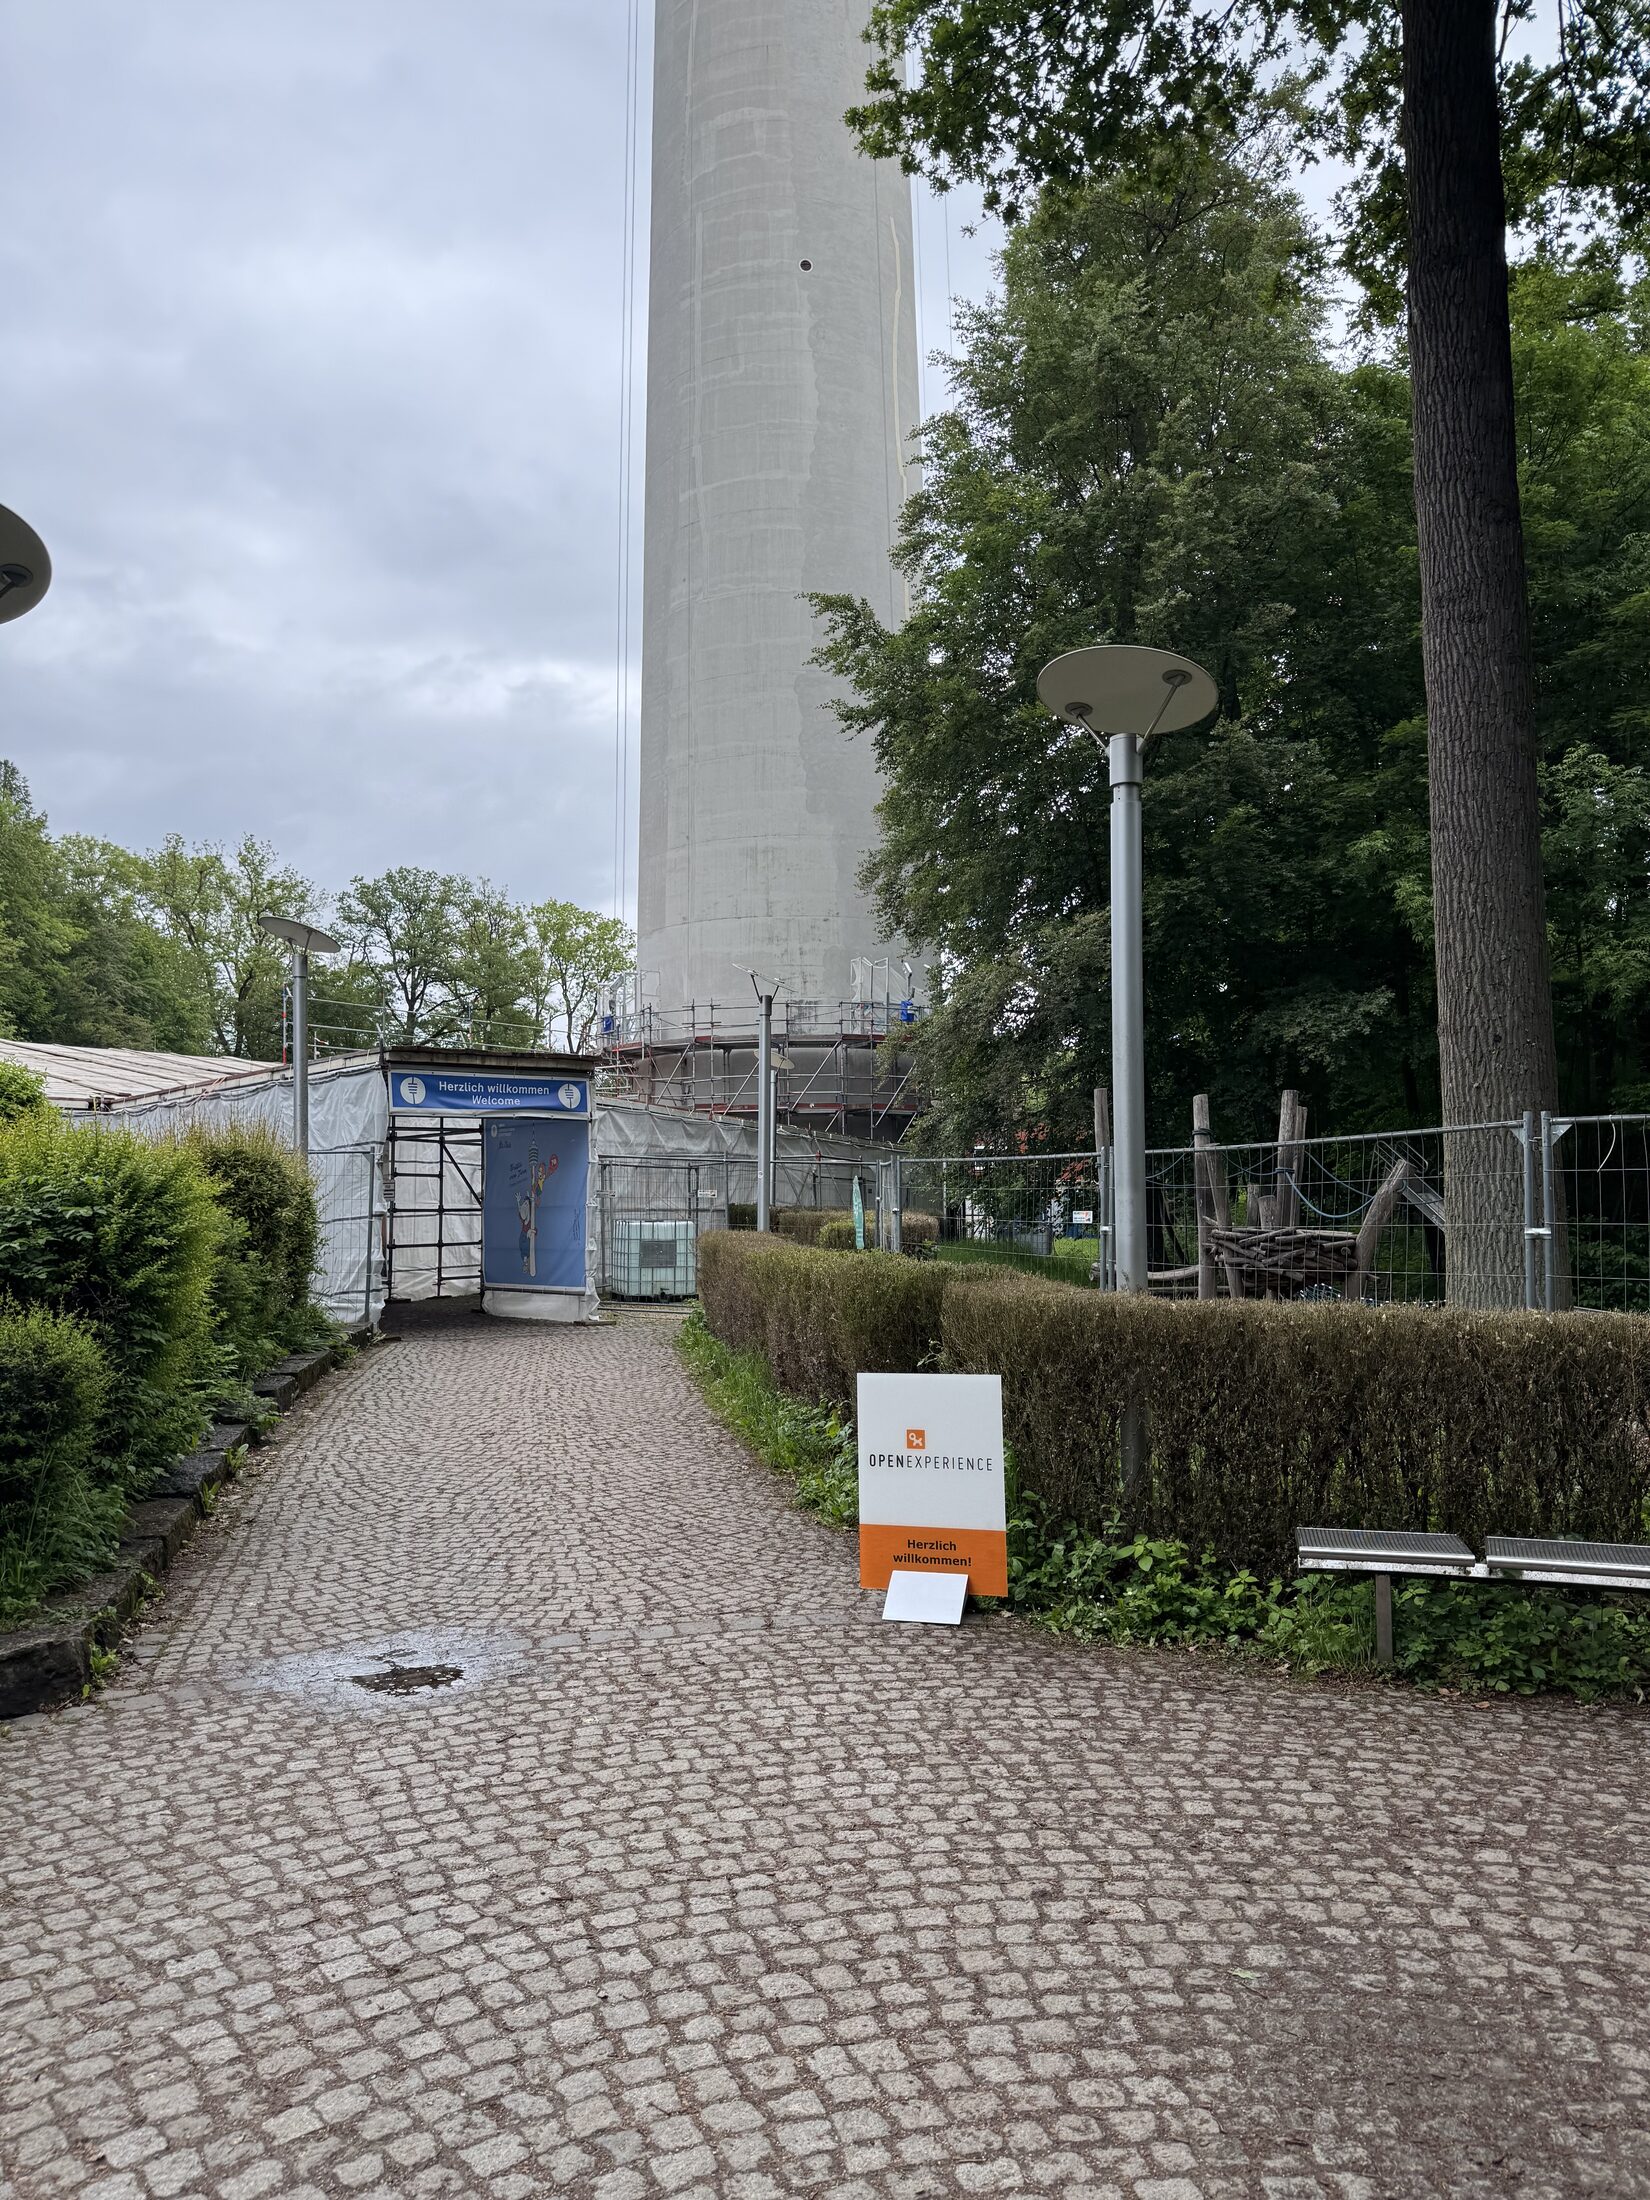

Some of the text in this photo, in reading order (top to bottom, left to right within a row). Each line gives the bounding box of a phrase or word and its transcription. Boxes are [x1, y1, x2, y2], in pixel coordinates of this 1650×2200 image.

[438, 1080, 550, 1096] Herzlich willkommen
[471, 1094, 521, 1106] Welcome
[907, 1539, 957, 1551] Herzlich
[893, 1553, 972, 1567] willkommen!
